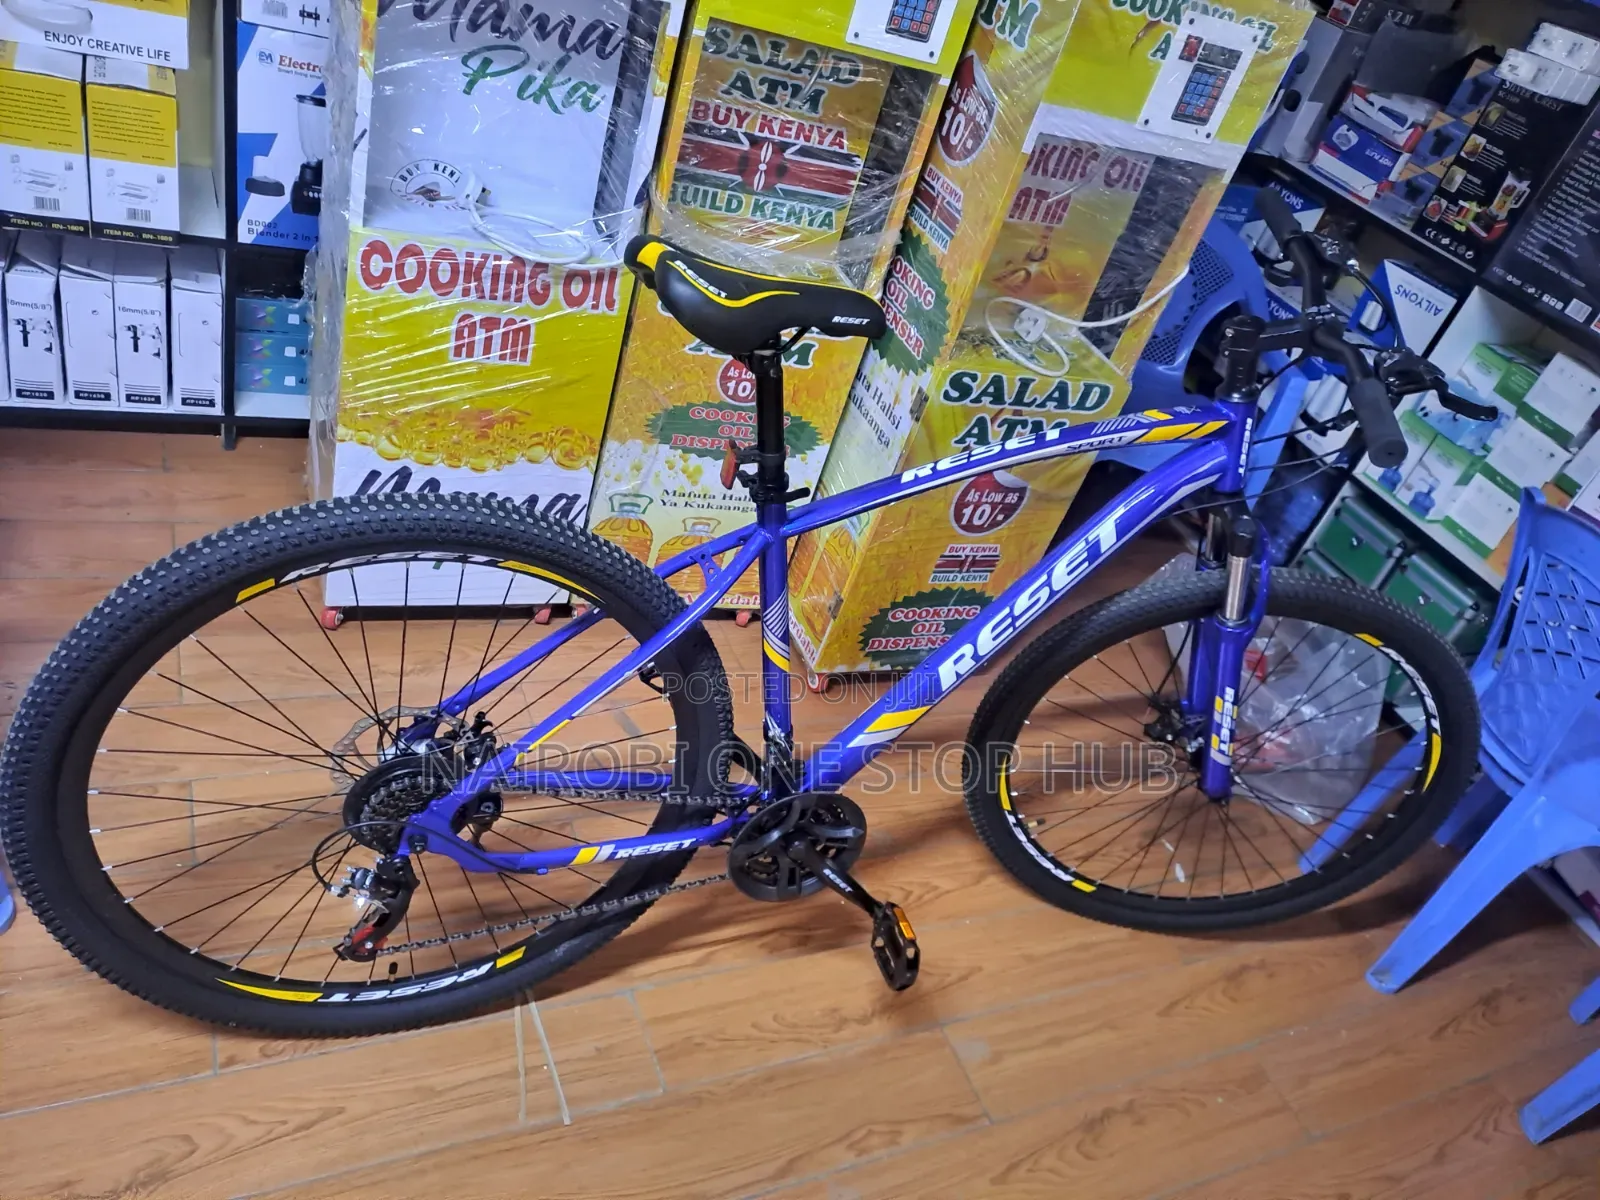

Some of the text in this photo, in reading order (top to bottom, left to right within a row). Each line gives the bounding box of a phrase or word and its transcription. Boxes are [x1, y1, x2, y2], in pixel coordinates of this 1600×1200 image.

[44, 31, 171, 62] ENJOY CREATIVE LIFE
[372, 0, 626, 60] ama
[703, 27, 861, 84] SALAD
[462, 44, 606, 115] Pika
[720, 70, 826, 115] ATM
[1535, 95, 1564, 111] CREST
[691, 101, 847, 150] BUY KENYA
[941, 106, 975, 153] 10/-
[398, 163, 420, 182] BUY
[927, 167, 963, 206] BUY KENYA
[669, 182, 836, 231] BUILD KENYA
[103, 228, 123, 236] ITEM
[247, 227, 290, 240] Blender
[293, 232, 299, 240] 2
[910, 206, 949, 252] BUILD KENYA
[360, 239, 619, 312] COOKING OIL
[675, 260, 728, 298] RESET
[887, 278, 908, 313] OIL
[1394, 284, 1444, 317] AILYONS
[453, 313, 533, 363] ATM
[832, 315, 870, 325] RESET
[727, 366, 739, 378] As
[872, 386, 902, 430] Halisi
[943, 371, 1112, 413] SALAD
[718, 425, 756, 439] OIL
[1238, 417, 1252, 477] RESET
[901, 428, 1129, 483] RESET SPORT
[660, 498, 757, 513] Ya Kukaanga
[661, 489, 716, 500] Mafuta
[965, 488, 1020, 504] As Low as
[961, 504, 1004, 528] 10/-
[931, 574, 989, 583] BUILD KENYA
[890, 606, 980, 622] COOKING
[938, 512, 1126, 692] RESET
[912, 622, 945, 635] OIL
[1220, 686, 1234, 755] RESET
[615, 838, 696, 859] RESET
[316, 961, 494, 1003] RESET
